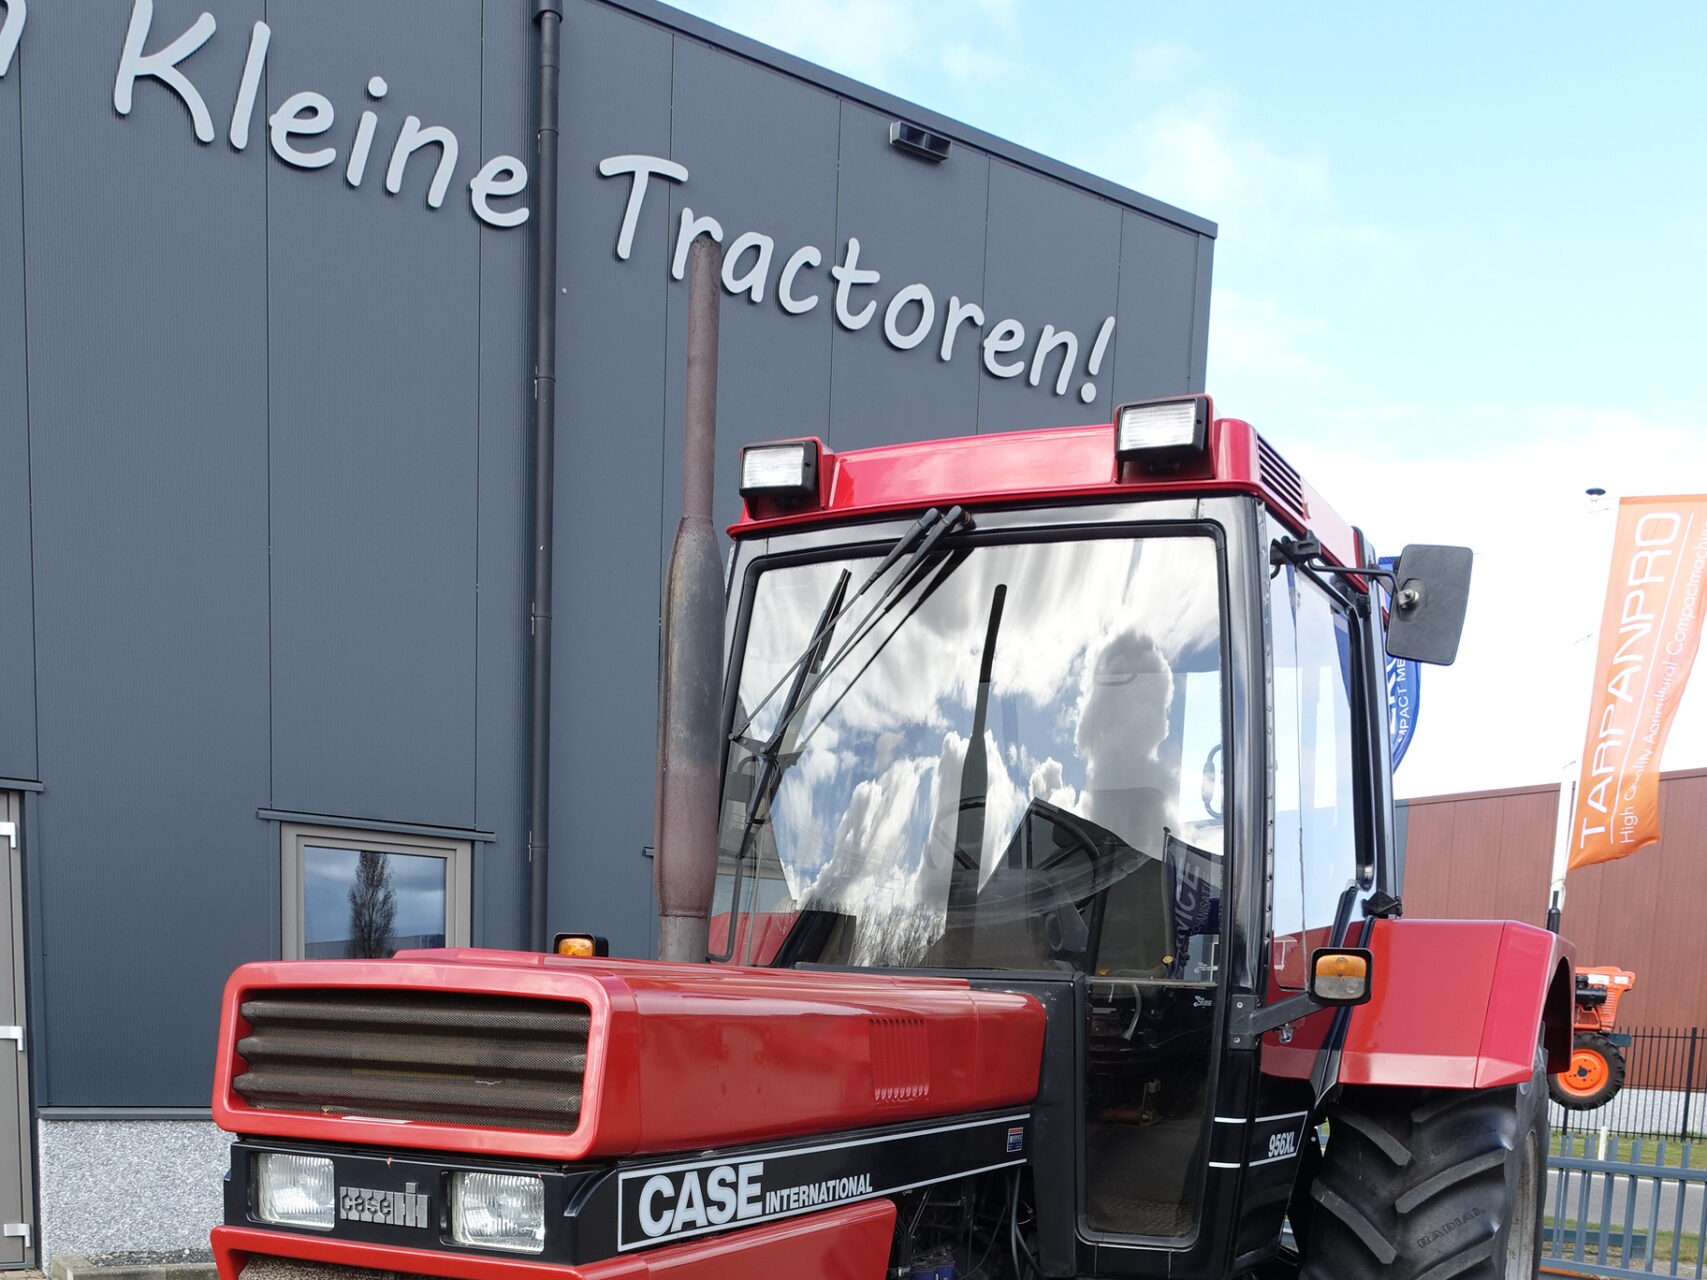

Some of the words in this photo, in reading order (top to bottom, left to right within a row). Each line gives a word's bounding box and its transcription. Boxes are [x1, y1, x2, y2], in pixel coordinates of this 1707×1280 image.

[115, 0, 530, 227] Kleine
[599, 154, 1116, 404] Tractoren!
[1620, 806, 1639, 844] High
[1268, 1131, 1295, 1158] 956XL
[638, 1161, 764, 1238] CASE
[765, 1172, 873, 1215] INTERNATIONAL
